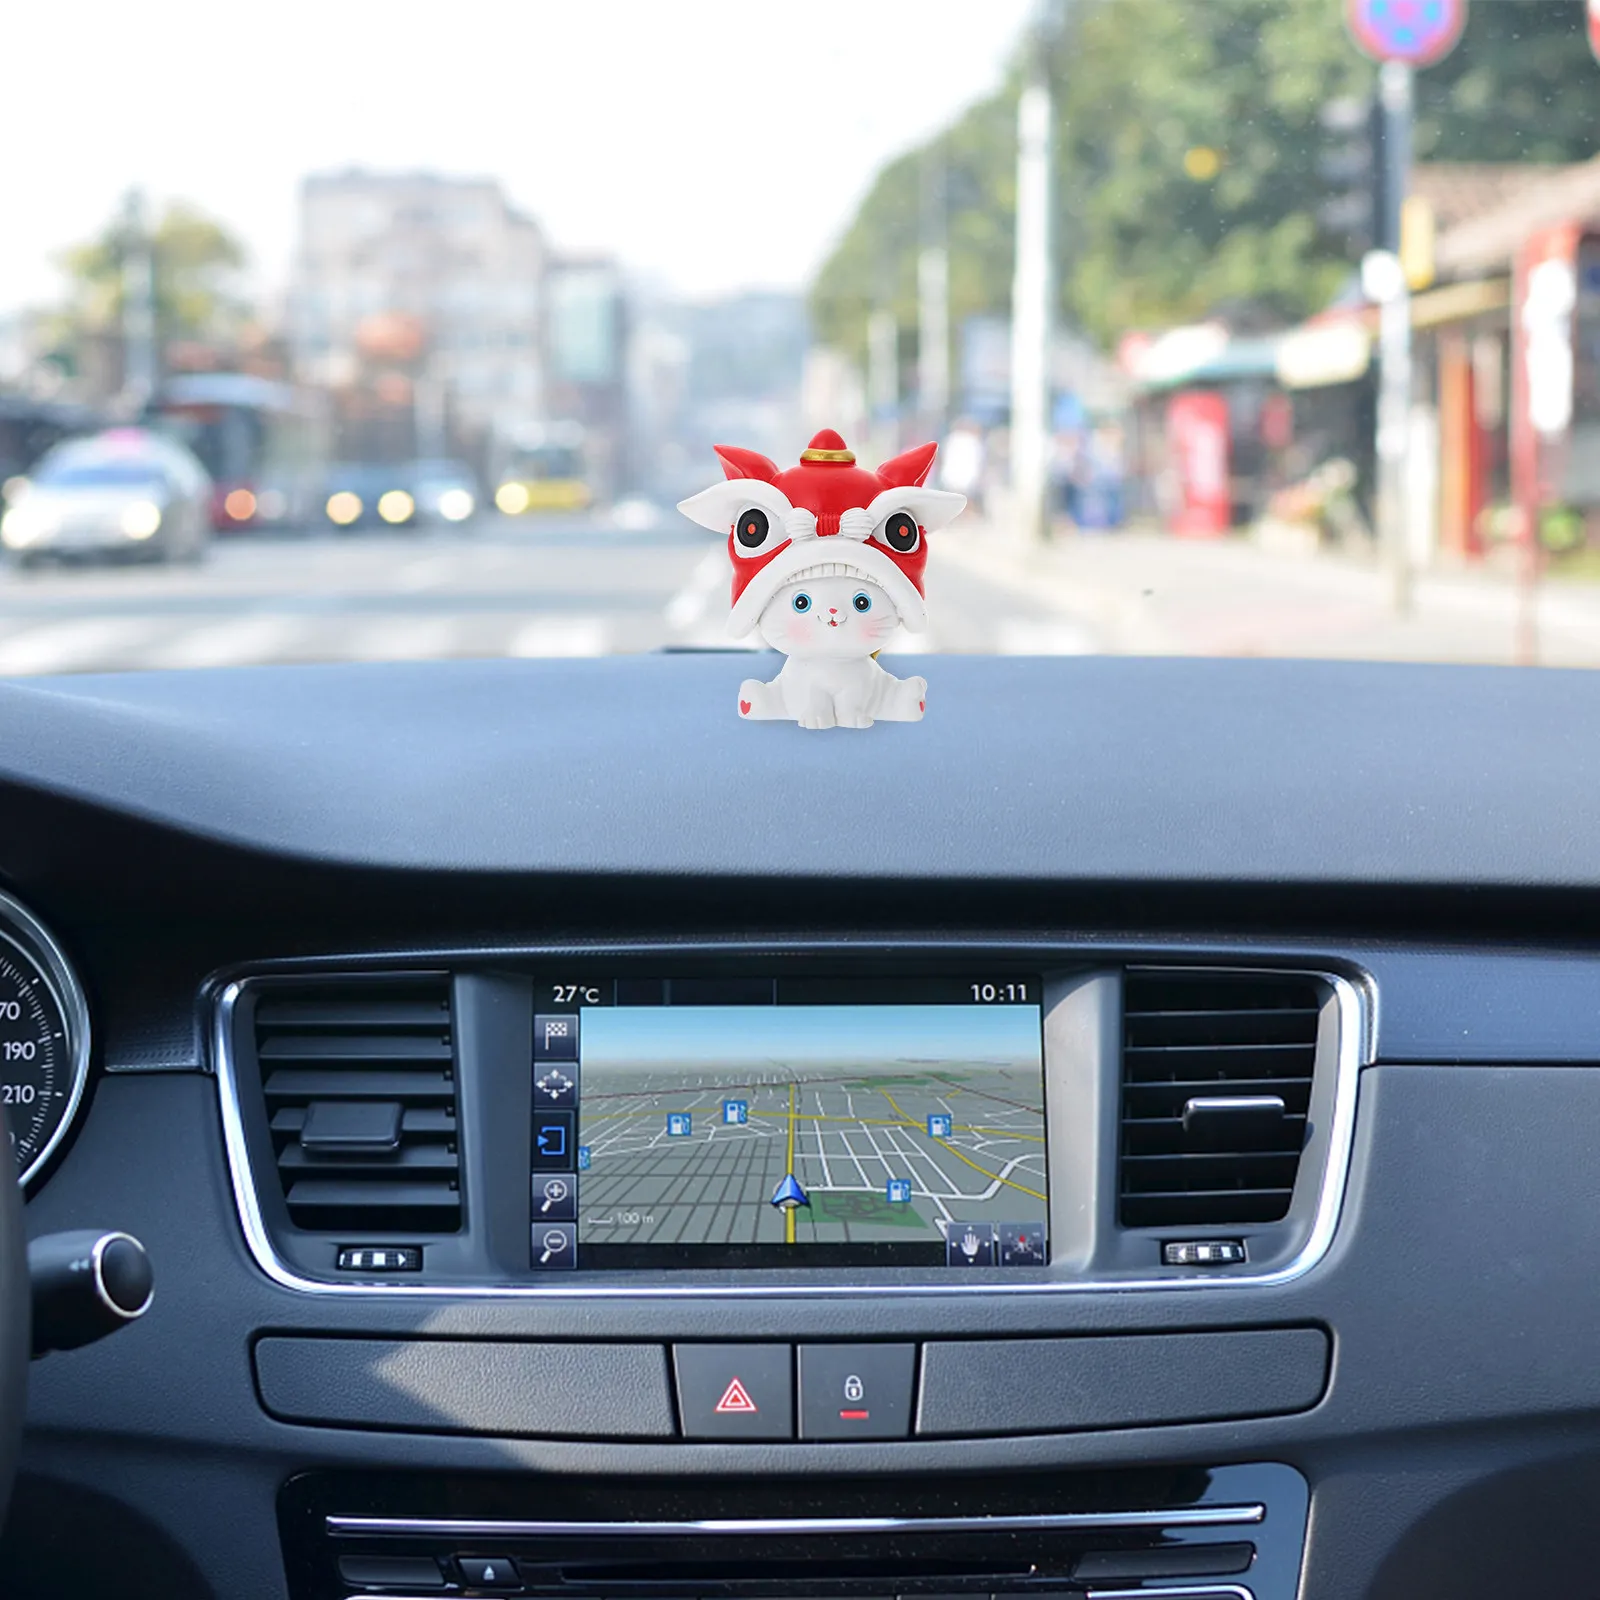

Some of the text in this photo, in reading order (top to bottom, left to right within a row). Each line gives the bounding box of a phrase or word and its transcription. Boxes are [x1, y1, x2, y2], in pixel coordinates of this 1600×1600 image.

[553, 985, 599, 1003] 27°C
[970, 984, 1026, 1001] 10:11
[3, 1041, 36, 1060] 190
[2, 1084, 35, 1104] 210
[617, 1212, 654, 1224] 100 m
